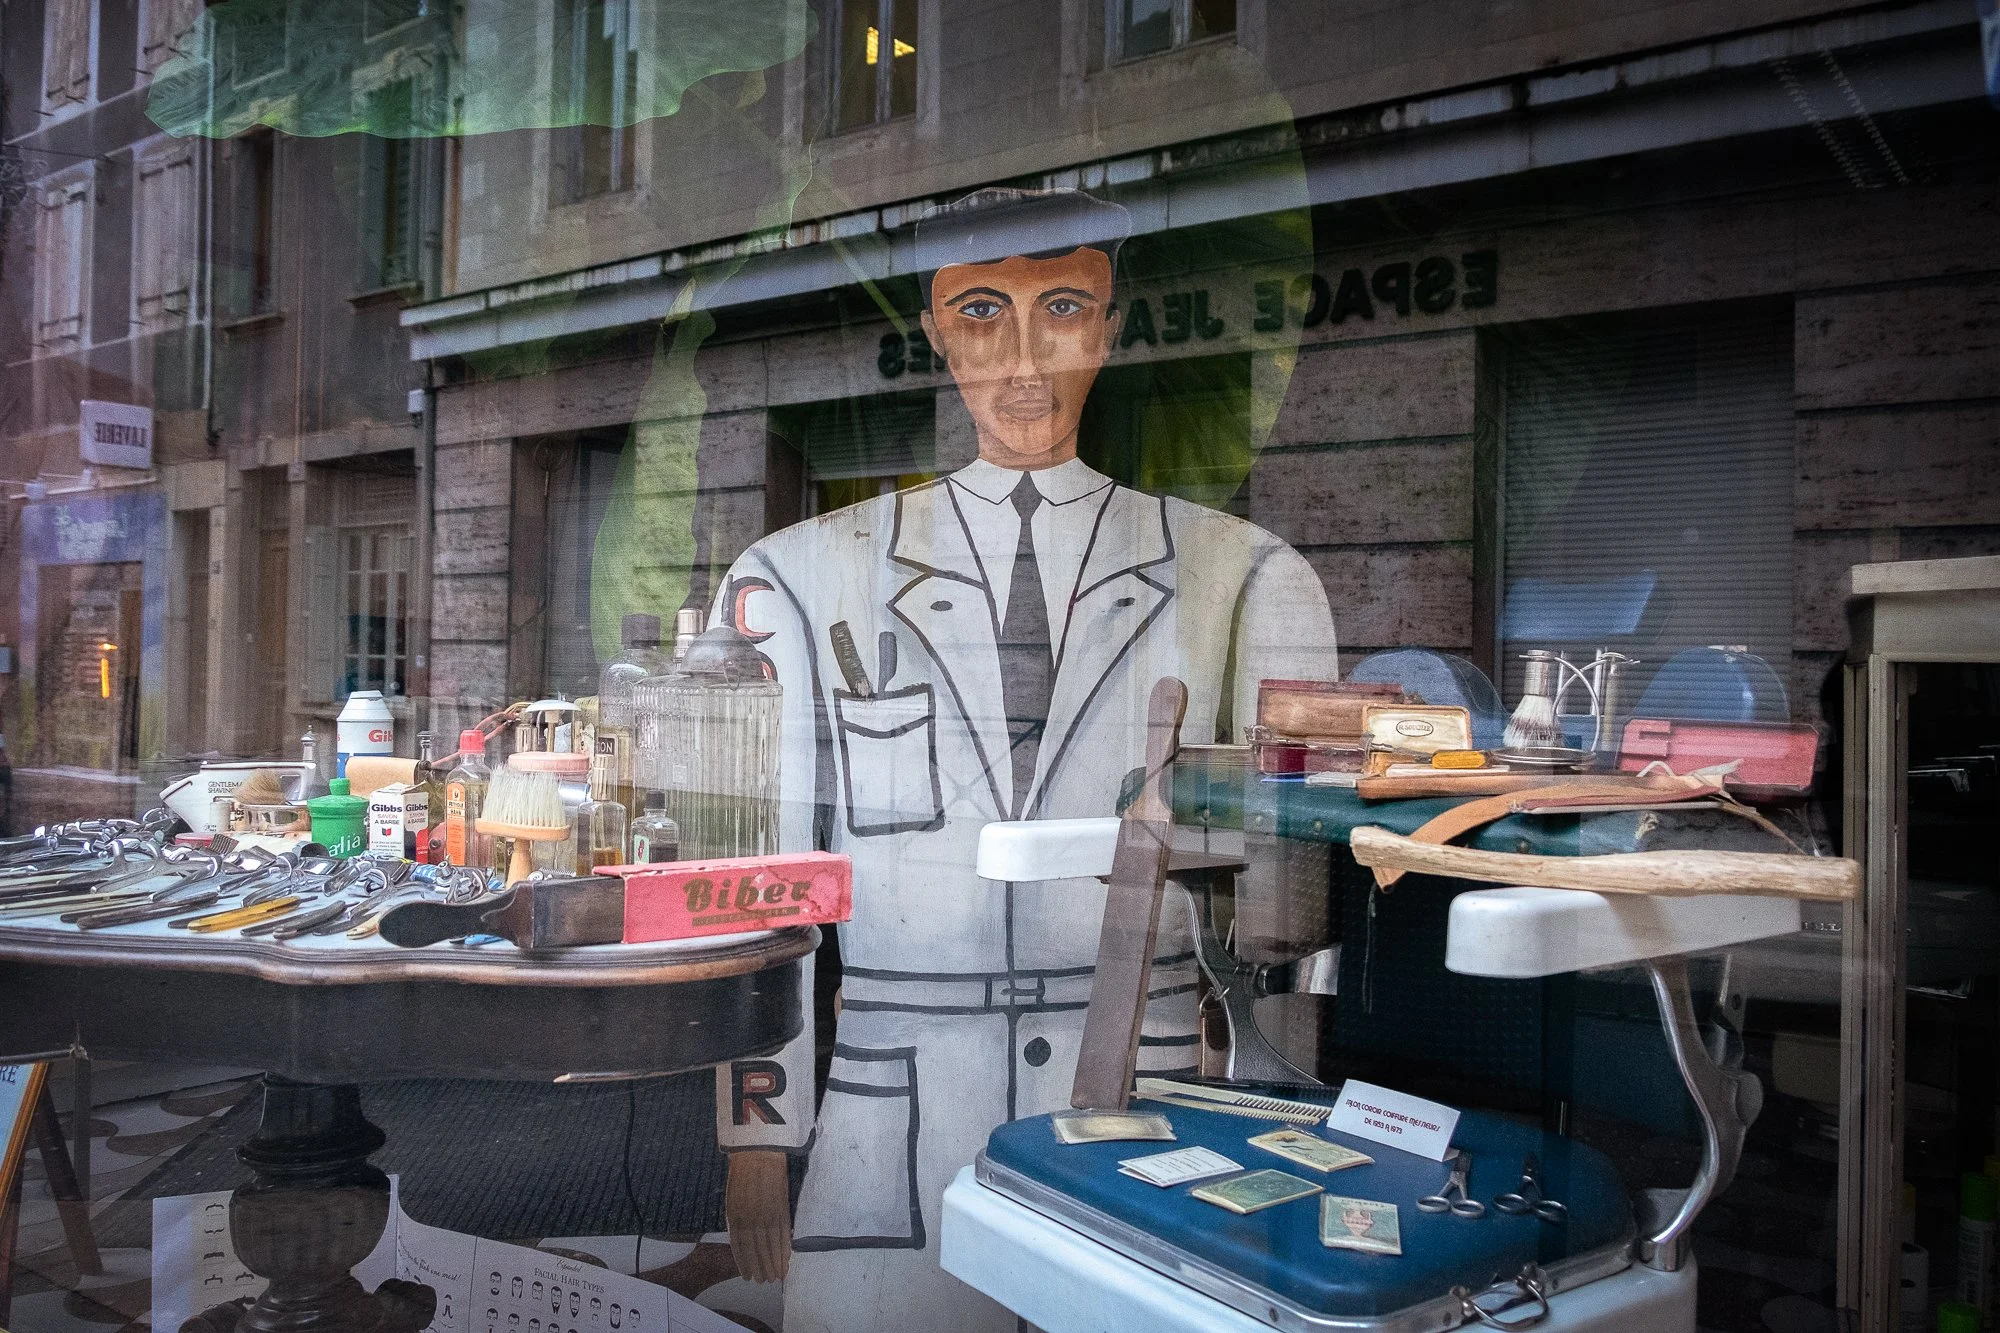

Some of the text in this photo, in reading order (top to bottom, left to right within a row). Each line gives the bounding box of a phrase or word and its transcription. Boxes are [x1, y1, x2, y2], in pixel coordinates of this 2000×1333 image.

[371, 803, 403, 812] Gibbs
[405, 803, 429, 812] Gibbs
[683, 876, 812, 913] Biber
[731, 1061, 786, 1126] R
[1364, 1117, 1372, 1125] DE
[1383, 1110, 1408, 1123] COIFFURE
[534, 1267, 559, 1282] FACIAL
[582, 1281, 605, 1293] TYPES
